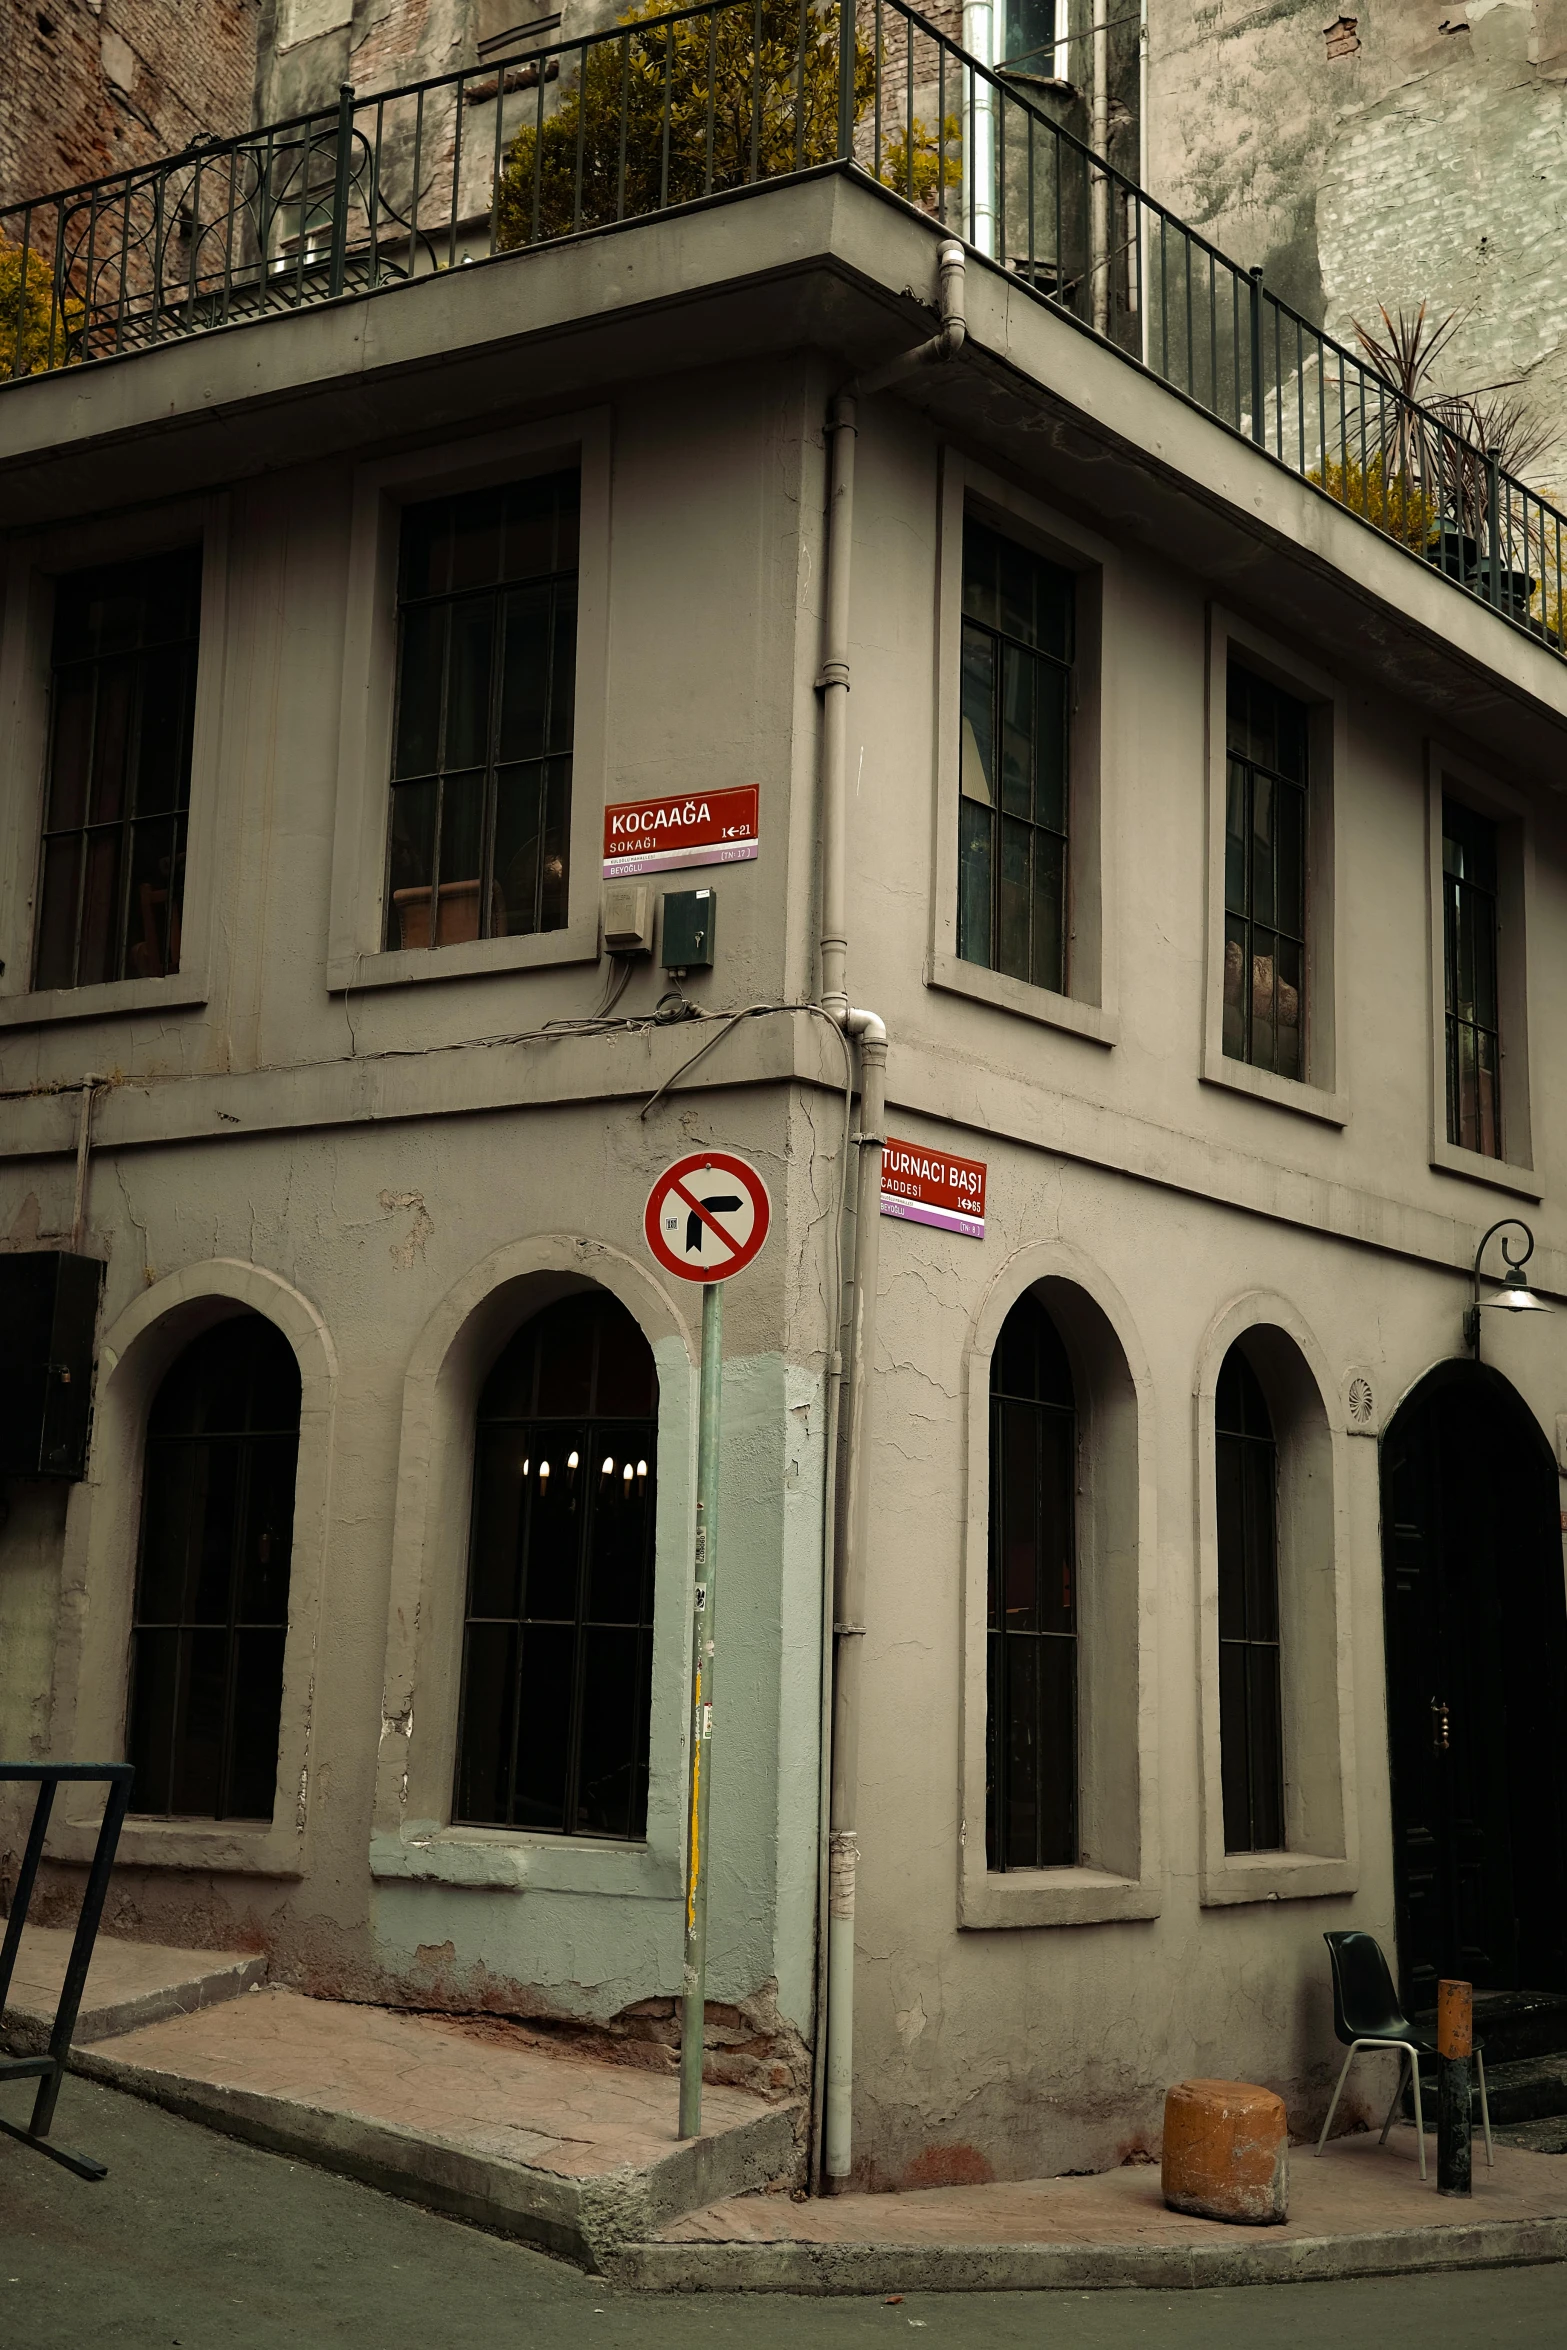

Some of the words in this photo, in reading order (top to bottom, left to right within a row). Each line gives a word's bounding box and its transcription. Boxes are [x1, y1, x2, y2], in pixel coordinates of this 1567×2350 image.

[612, 801, 711, 834] KOCAAĞA
[609, 836, 656, 853] SOKAĞI
[610, 863, 643, 875] BEYOĞLU
[882, 1148, 945, 1184] TURNACI
[949, 1167, 982, 1195] BAŞI
[881, 1176, 922, 1198] CADDESİ
